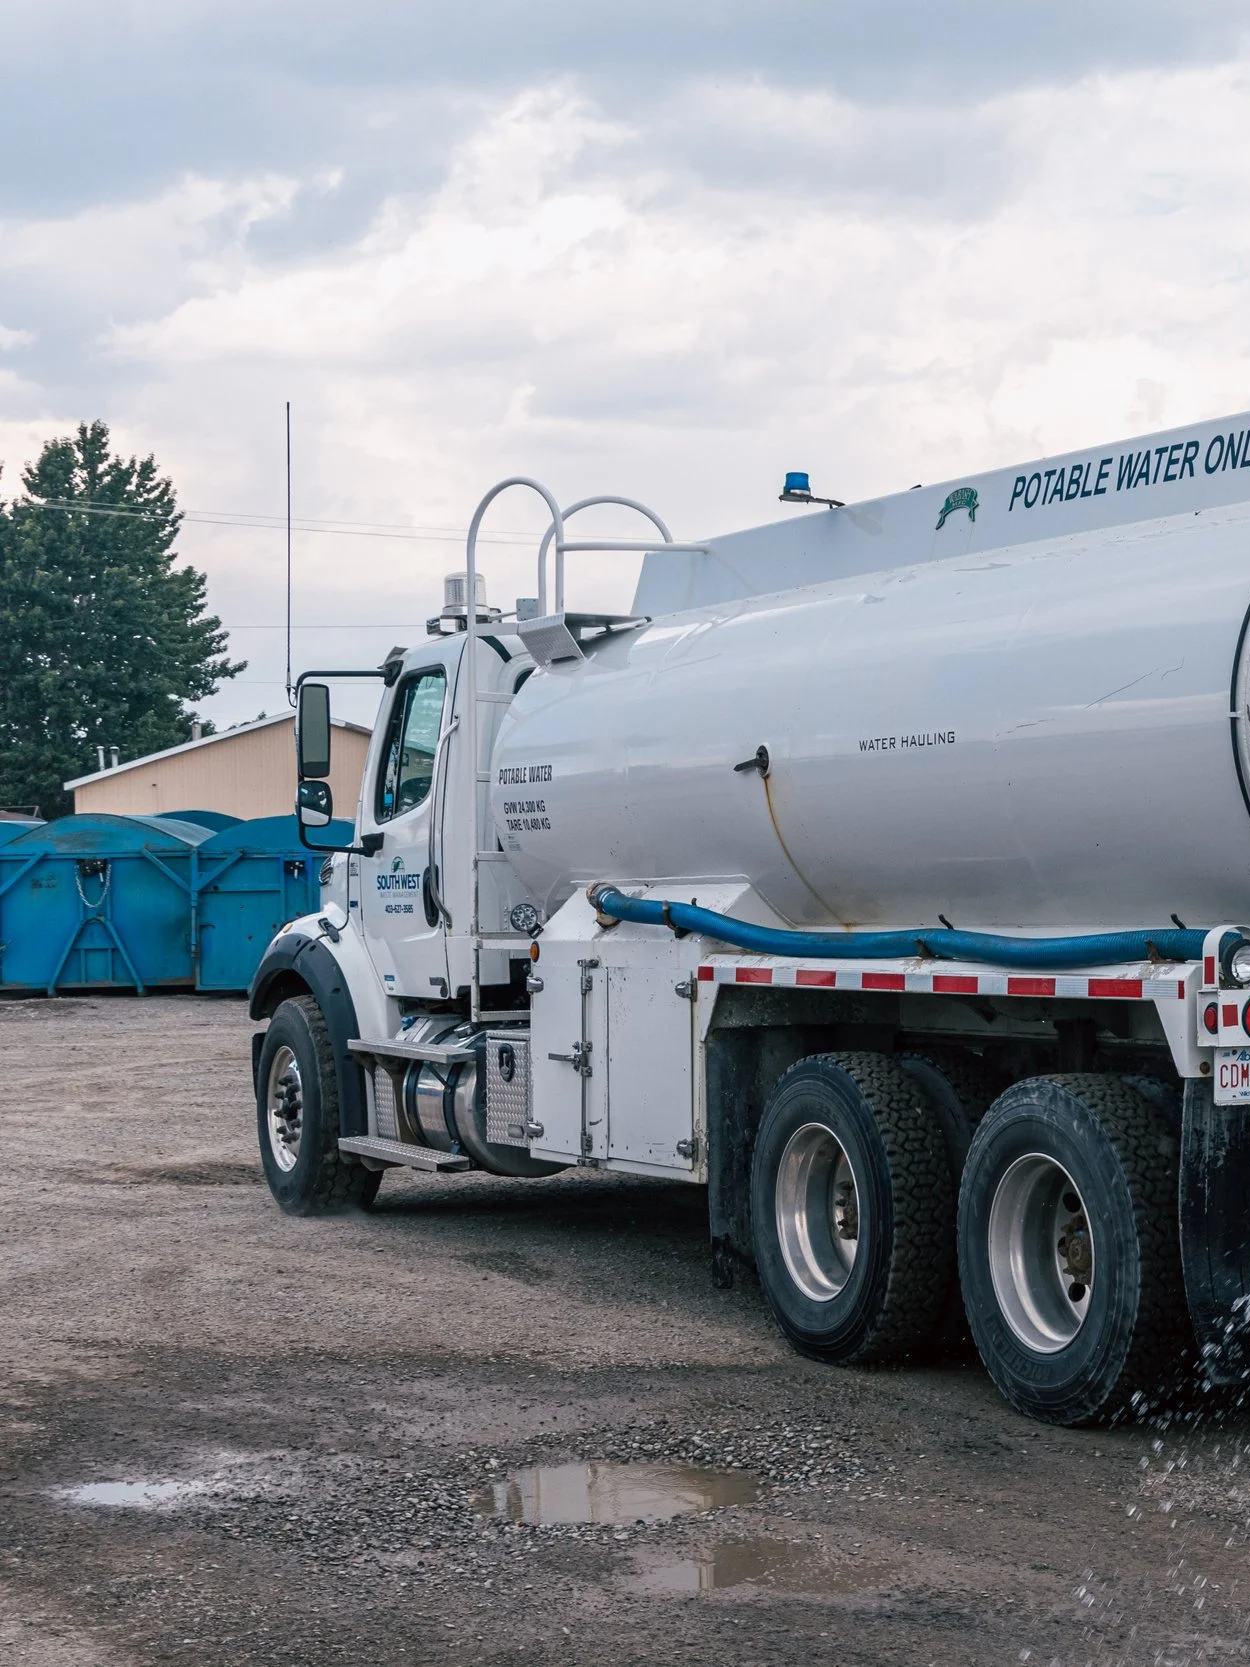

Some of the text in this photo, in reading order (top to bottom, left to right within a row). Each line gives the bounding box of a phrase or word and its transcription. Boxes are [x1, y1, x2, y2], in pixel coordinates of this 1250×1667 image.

[1008, 458, 1113, 512] POTABLE
[1116, 440, 1199, 490] WATER
[859, 731, 955, 752] WATER HAULING
[499, 765, 552, 785] POTABLE WATER
[504, 802, 518, 814] GVW
[536, 799, 546, 813] KG
[506, 818, 523, 831] TARE
[541, 817, 551, 830] KG
